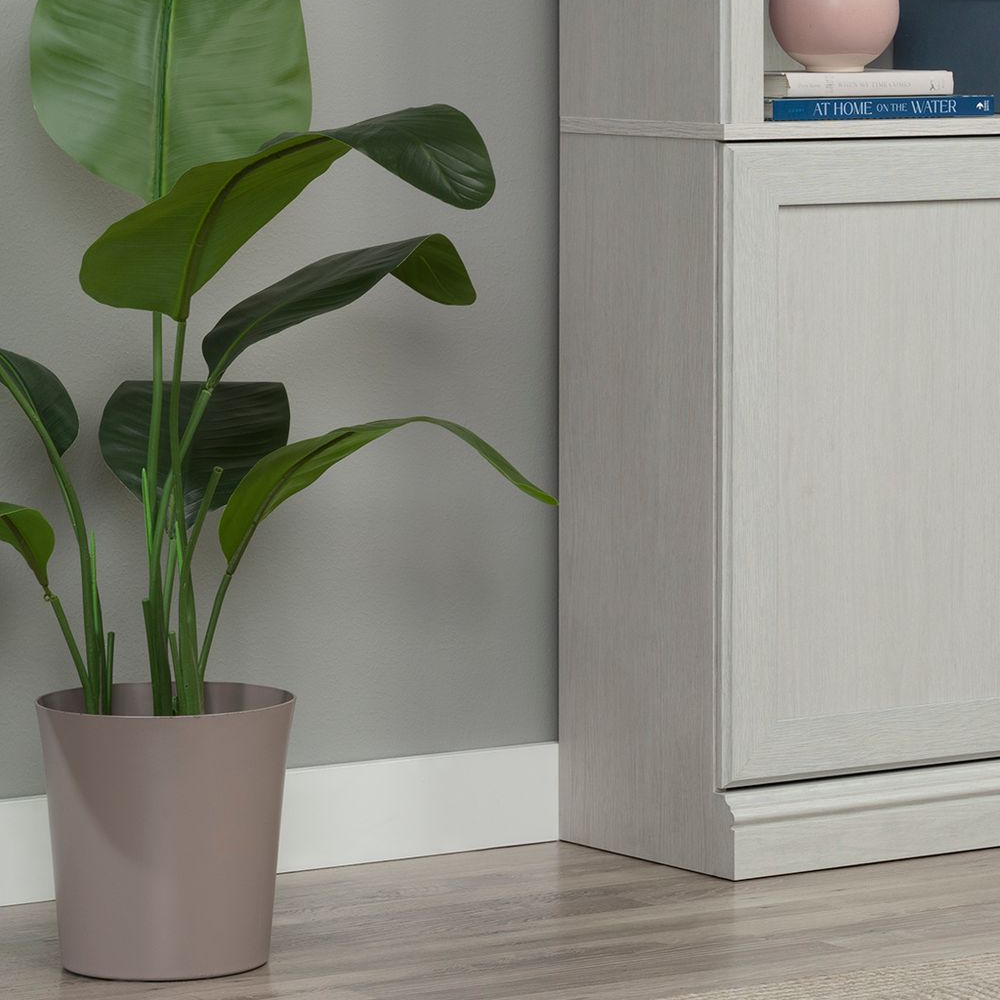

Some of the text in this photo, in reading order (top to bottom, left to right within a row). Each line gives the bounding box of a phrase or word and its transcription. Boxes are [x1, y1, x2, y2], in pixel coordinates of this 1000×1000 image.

[813, 99, 957, 116] AT HOME ON THE WATER
